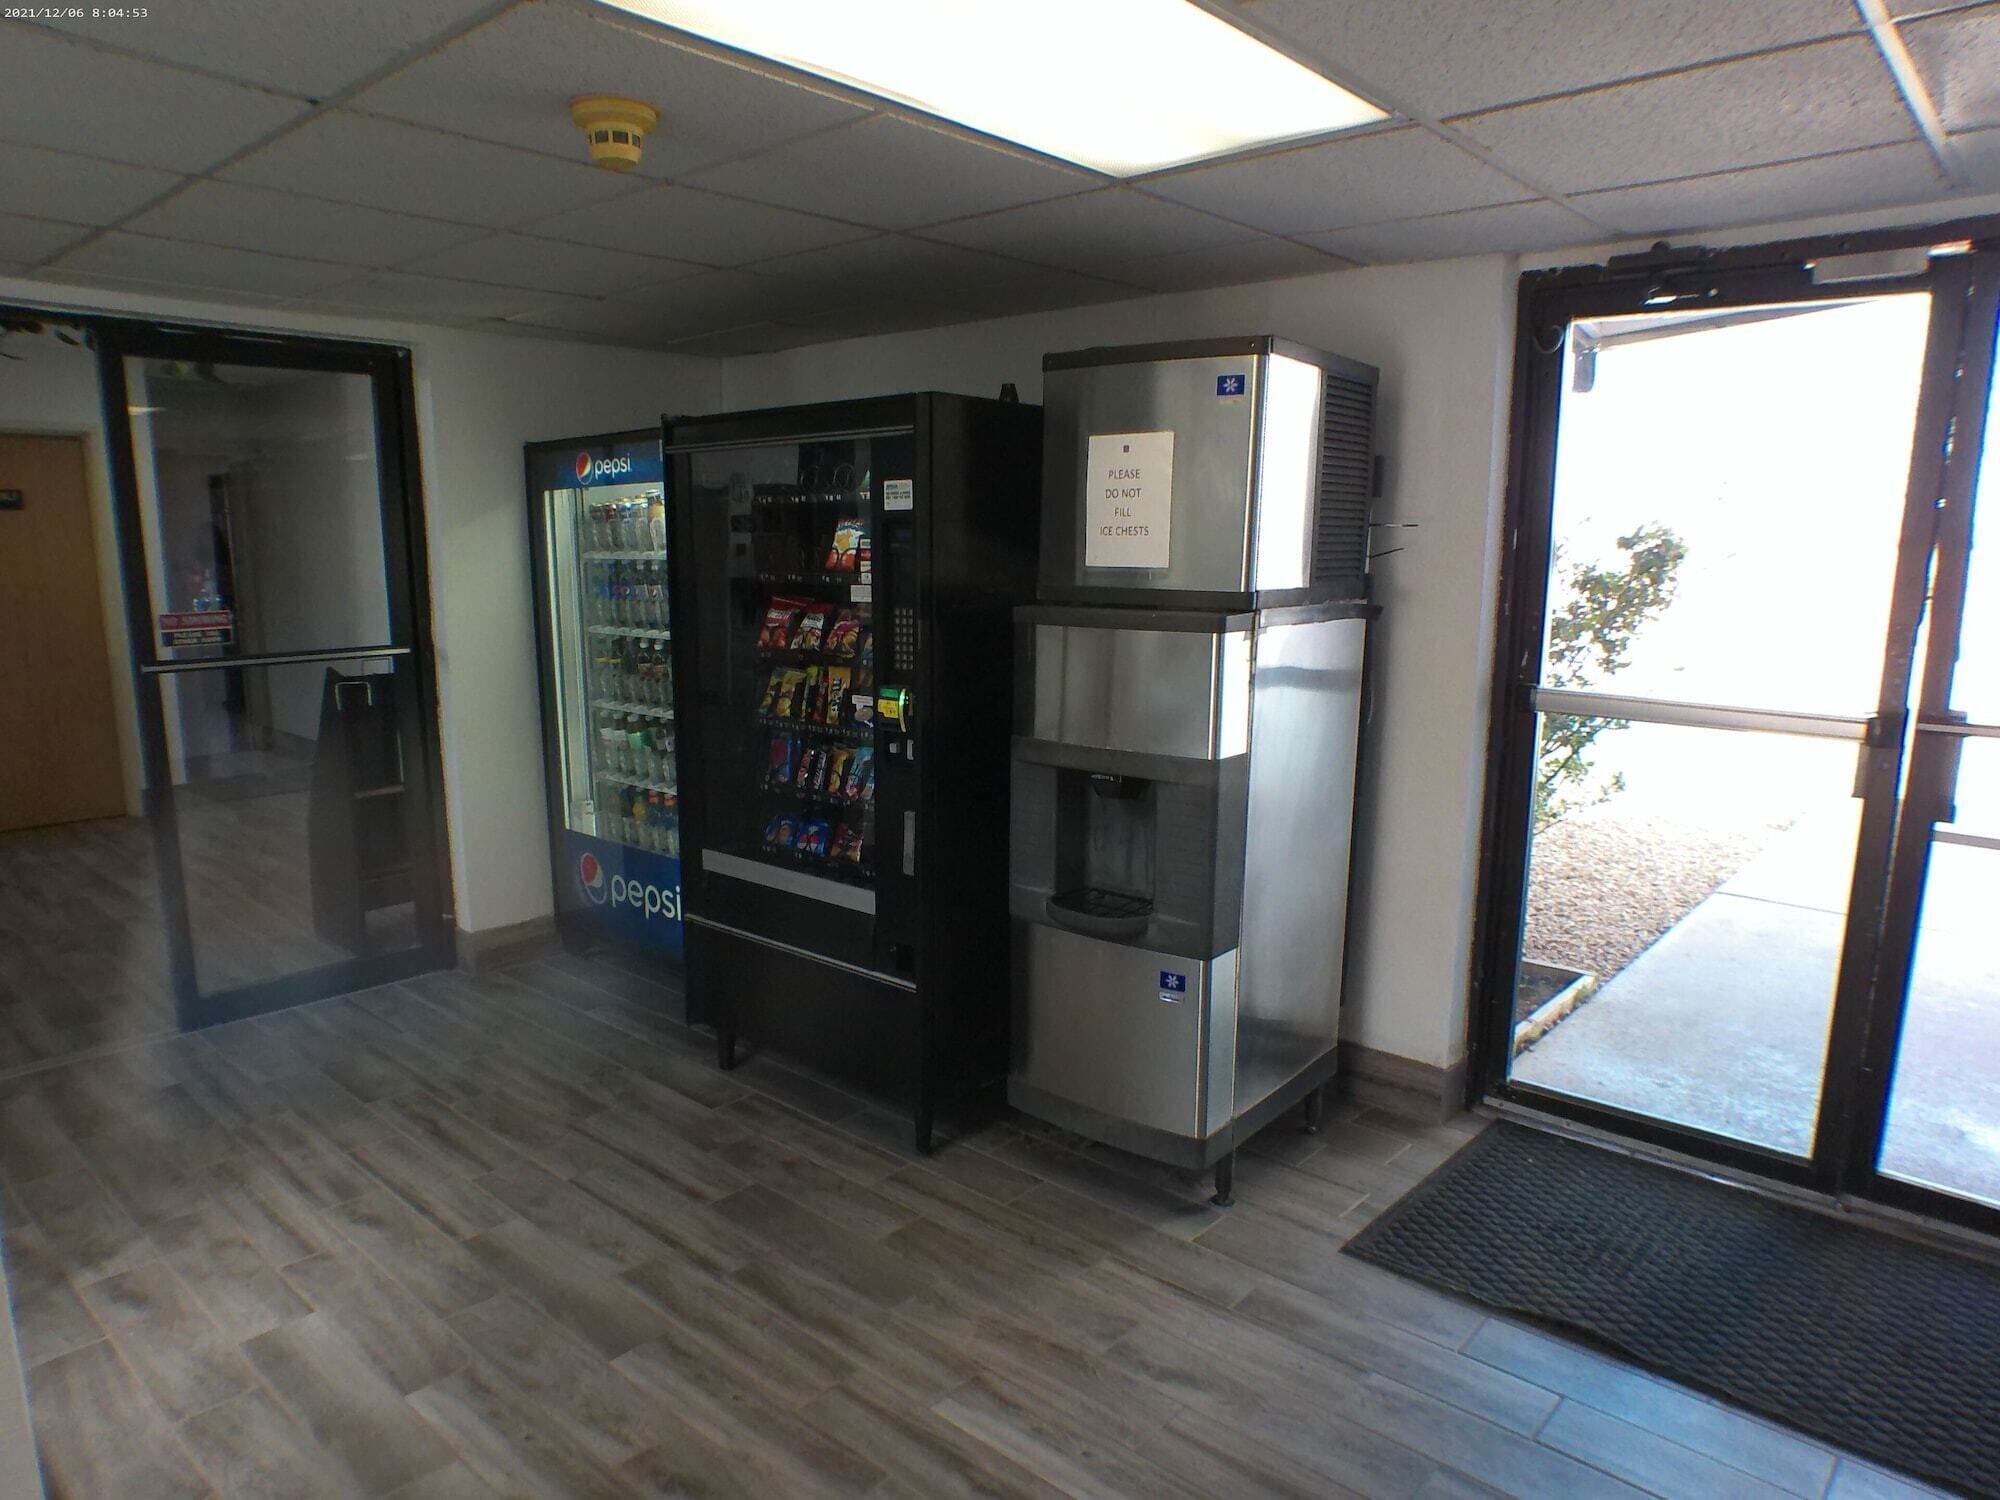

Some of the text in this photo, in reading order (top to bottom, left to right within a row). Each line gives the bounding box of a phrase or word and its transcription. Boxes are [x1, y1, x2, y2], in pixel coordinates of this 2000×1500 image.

[594, 452, 631, 480] pepsi
[1108, 469, 1141, 479] PLEASE
[1105, 488, 1142, 499] DO NOT
[1114, 507, 1132, 517] FILL
[1100, 526, 1149, 536] ICE CHESTS
[611, 874, 682, 921] pepsi
